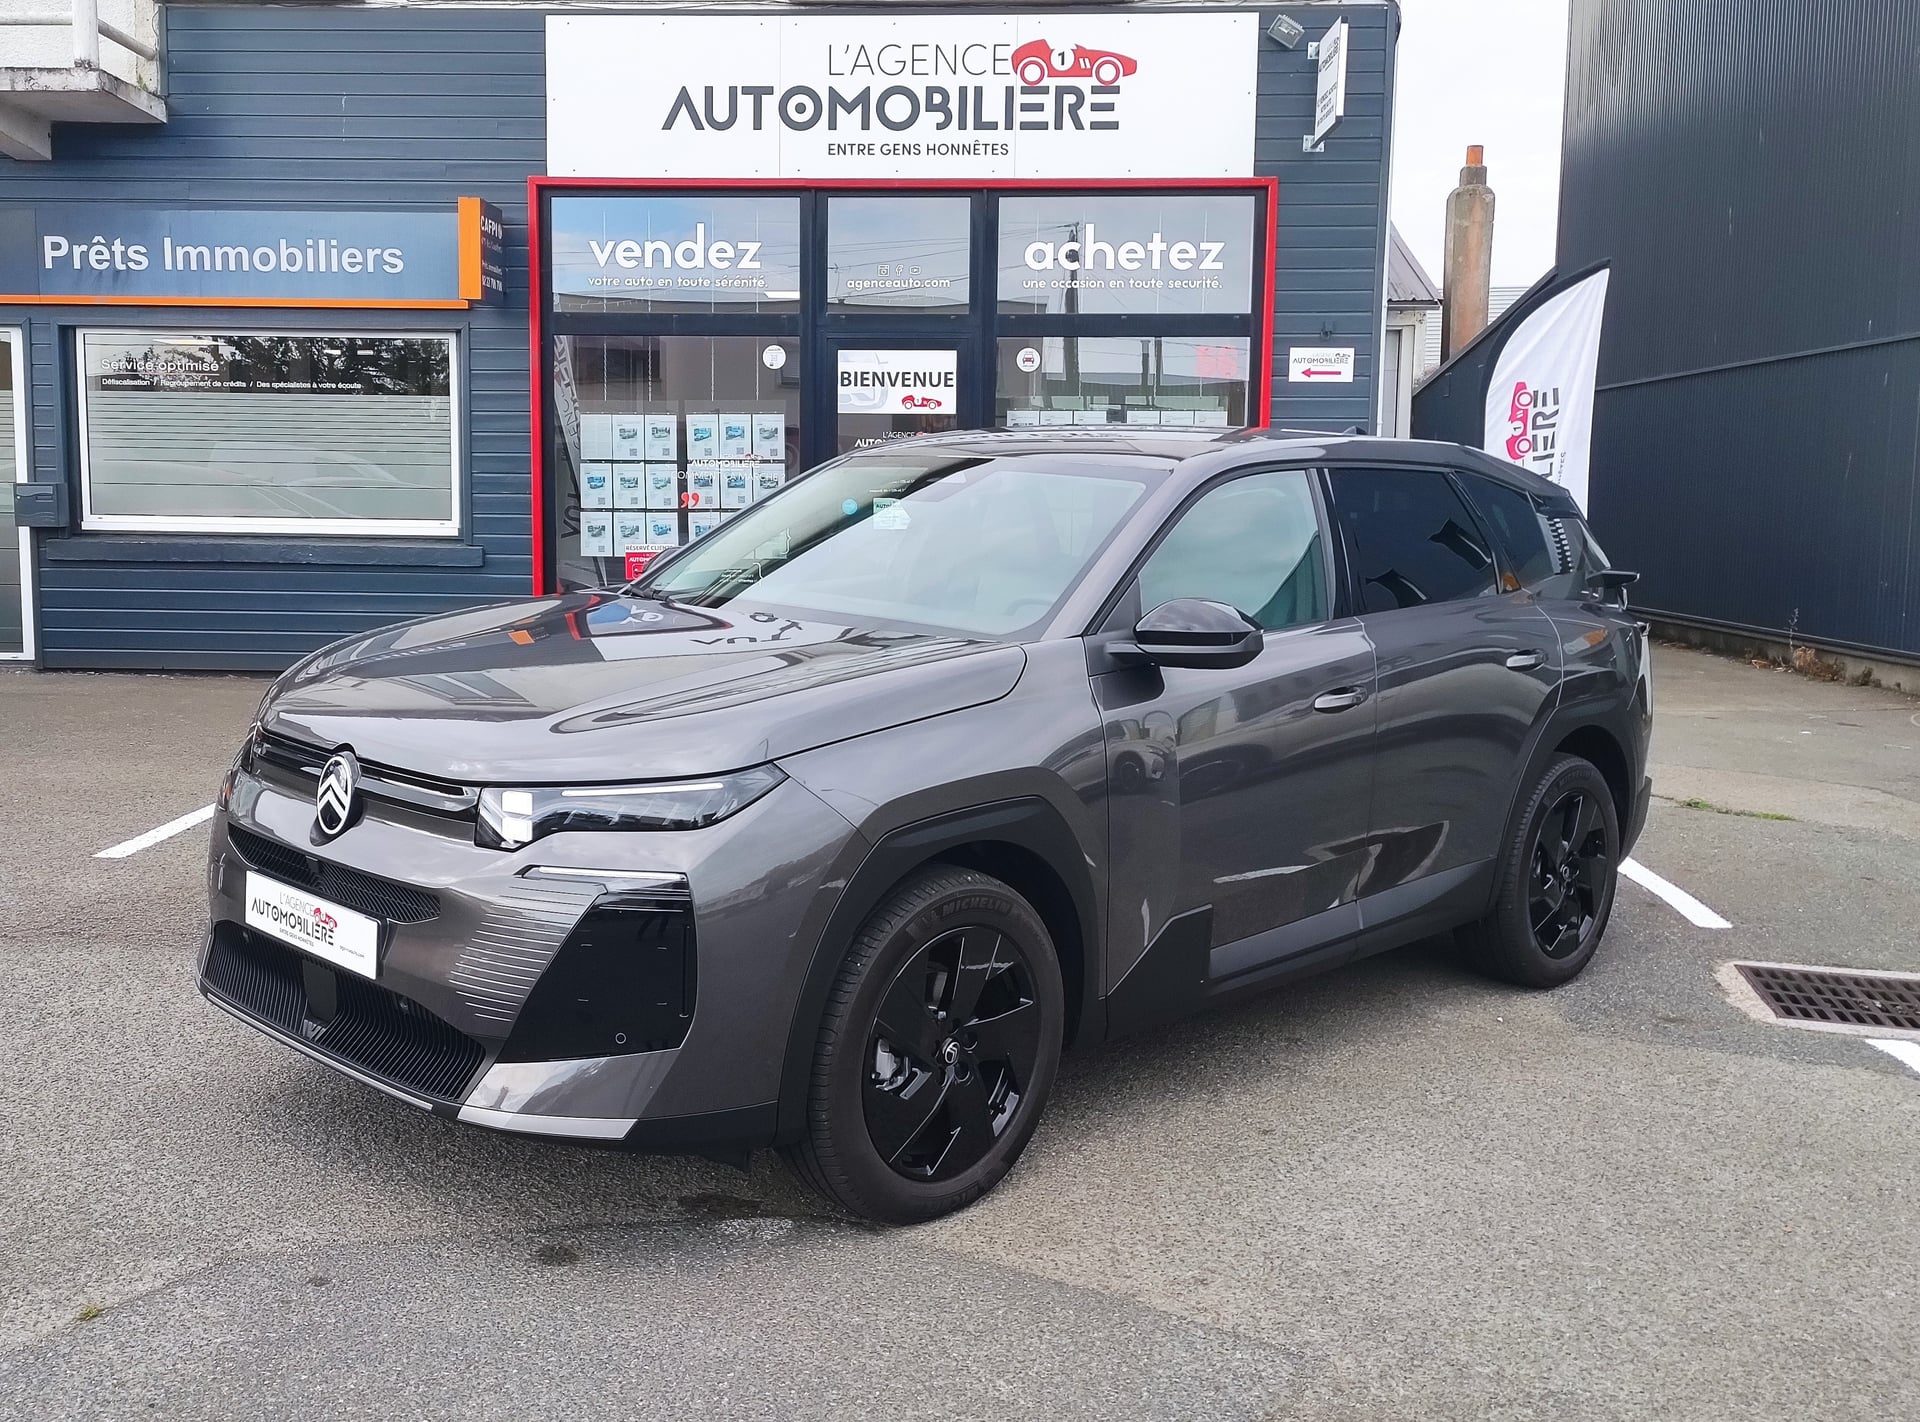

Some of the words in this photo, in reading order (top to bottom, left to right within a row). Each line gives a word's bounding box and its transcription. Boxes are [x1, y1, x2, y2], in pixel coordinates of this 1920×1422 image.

[828, 43, 1011, 76] L'AGENCE
[1057, 50, 1066, 66] 1
[661, 85, 1121, 131] AUTOMOBILIERE
[828, 143, 876, 156] ENTRE
[879, 143, 921, 156] GENS
[926, 139, 1009, 156] HONNÊTES
[480, 215, 498, 238] CAFPI
[43, 235, 149, 270] Prêts
[163, 236, 405, 273] Immobiliers
[588, 222, 762, 269] vendez
[1024, 223, 1225, 270] achetez
[588, 275, 620, 287] votre
[624, 276, 654, 287] auto
[657, 278, 673, 287] en
[677, 276, 711, 287] toute
[714, 274, 769, 288] sérénité.
[847, 277, 951, 290] agenceauto.com
[1023, 279, 1046, 288] une
[1051, 276, 1104, 288] occasion
[1109, 278, 1124, 288] en
[1129, 276, 1163, 288] toute
[1168, 276, 1223, 288] securité.
[101, 358, 153, 370] Service
[158, 360, 219, 373] optimisé
[840, 371, 954, 387] BIENVENUE
[280, 892, 315, 918] L'AGENCE
[942, 896, 1011, 916] MICHELIN
